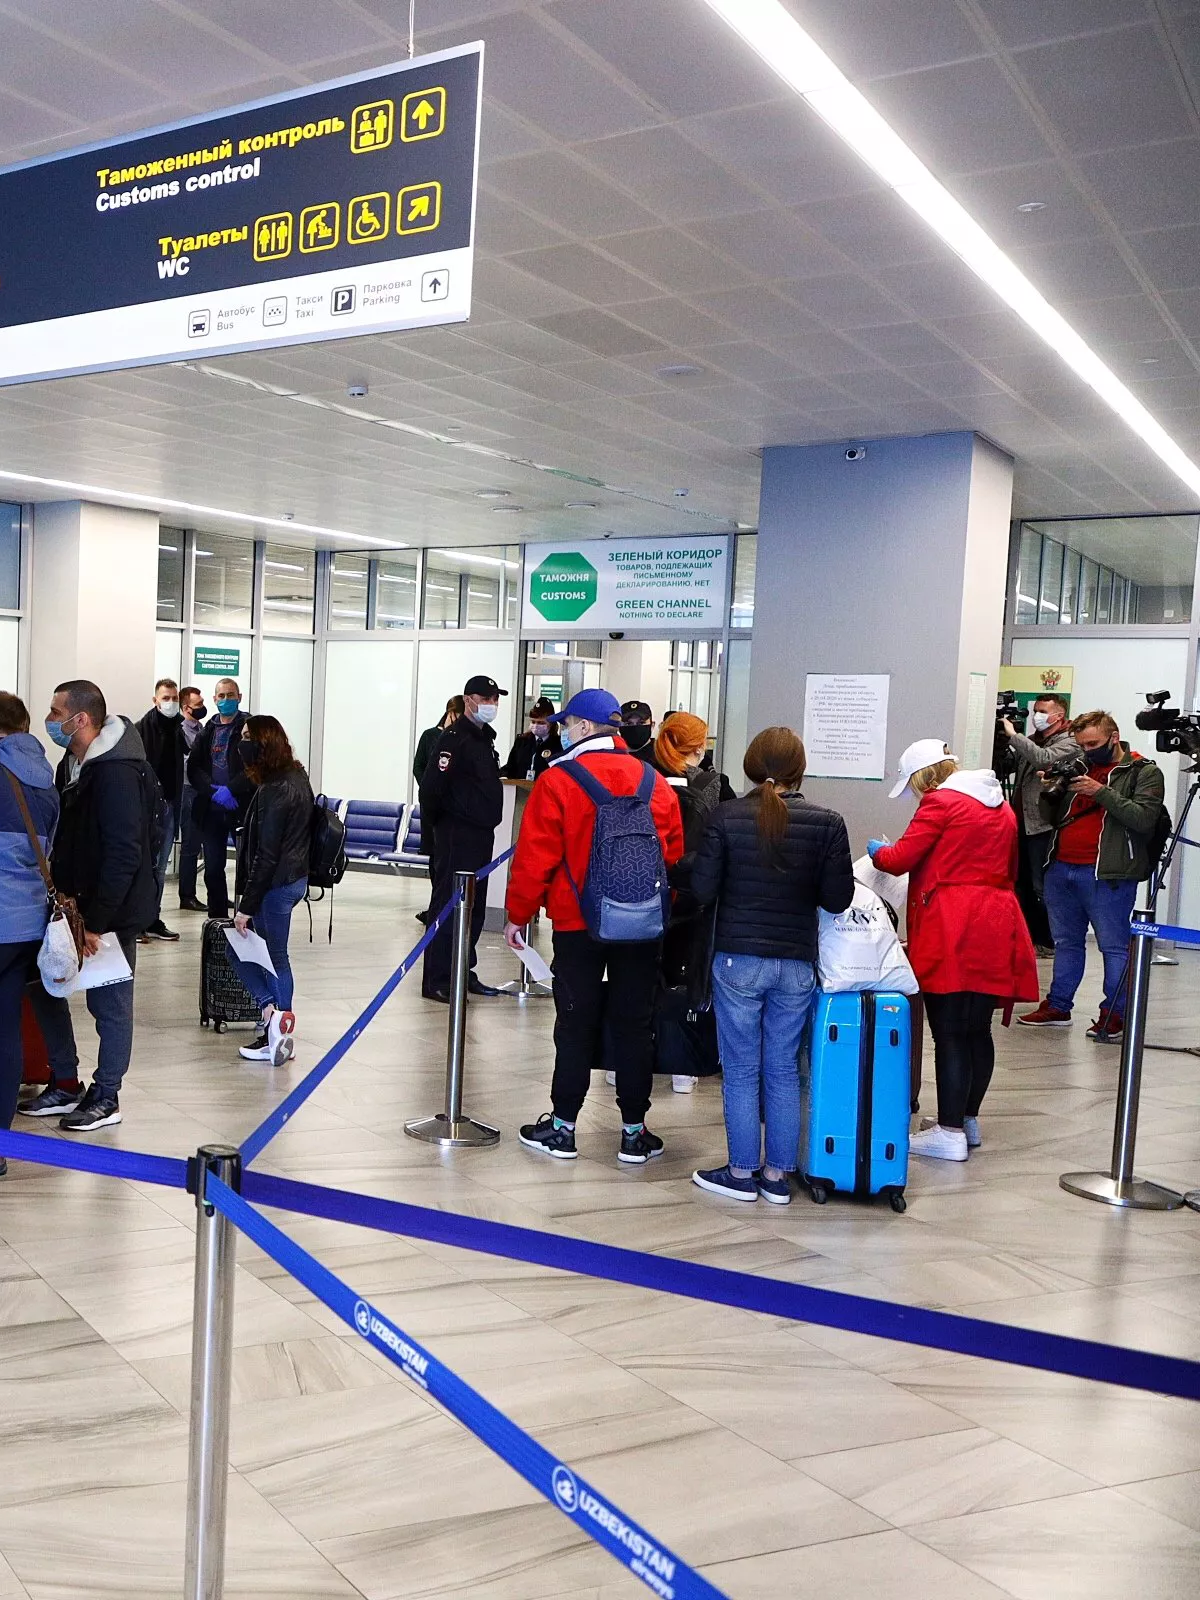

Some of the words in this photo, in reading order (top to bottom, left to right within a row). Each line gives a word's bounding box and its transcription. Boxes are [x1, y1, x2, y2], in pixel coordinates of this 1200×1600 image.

[97, 140, 232, 188] Таможенный
[238, 116, 346, 155] контроль
[96, 180, 180, 212] Customs
[185, 157, 261, 192] control
[158, 225, 249, 258] Туалеты
[157, 257, 190, 280] WC
[363, 278, 412, 294] Парковка
[295, 294, 323, 306] Такси
[362, 294, 400, 307] Parking
[217, 305, 256, 318] Автобус
[295, 308, 314, 319] Taxi
[217, 321, 234, 331] Bus
[608, 550, 664, 562] ЗЕЛЕНЫЙ
[666, 549, 723, 561] КОРИДОР
[655, 561, 713, 570] ПОДЛЕЖАЩИХ
[539, 573, 590, 583] ТАМОЖНЯ
[633, 571, 693, 580] ПИСЬМЕННОМУ
[694, 579, 710, 587] НЕТ
[541, 591, 586, 601] CUSTOMS
[615, 600, 654, 609] GREEN
[657, 599, 712, 609] CHANNEL
[619, 611, 653, 619] NOTHING
[655, 611, 665, 619] TO
[1130, 923, 1160, 932] KISTAN
[370, 1315, 429, 1376] UZBEKISTAN
[579, 1489, 676, 1581] UZBEKISTAN
